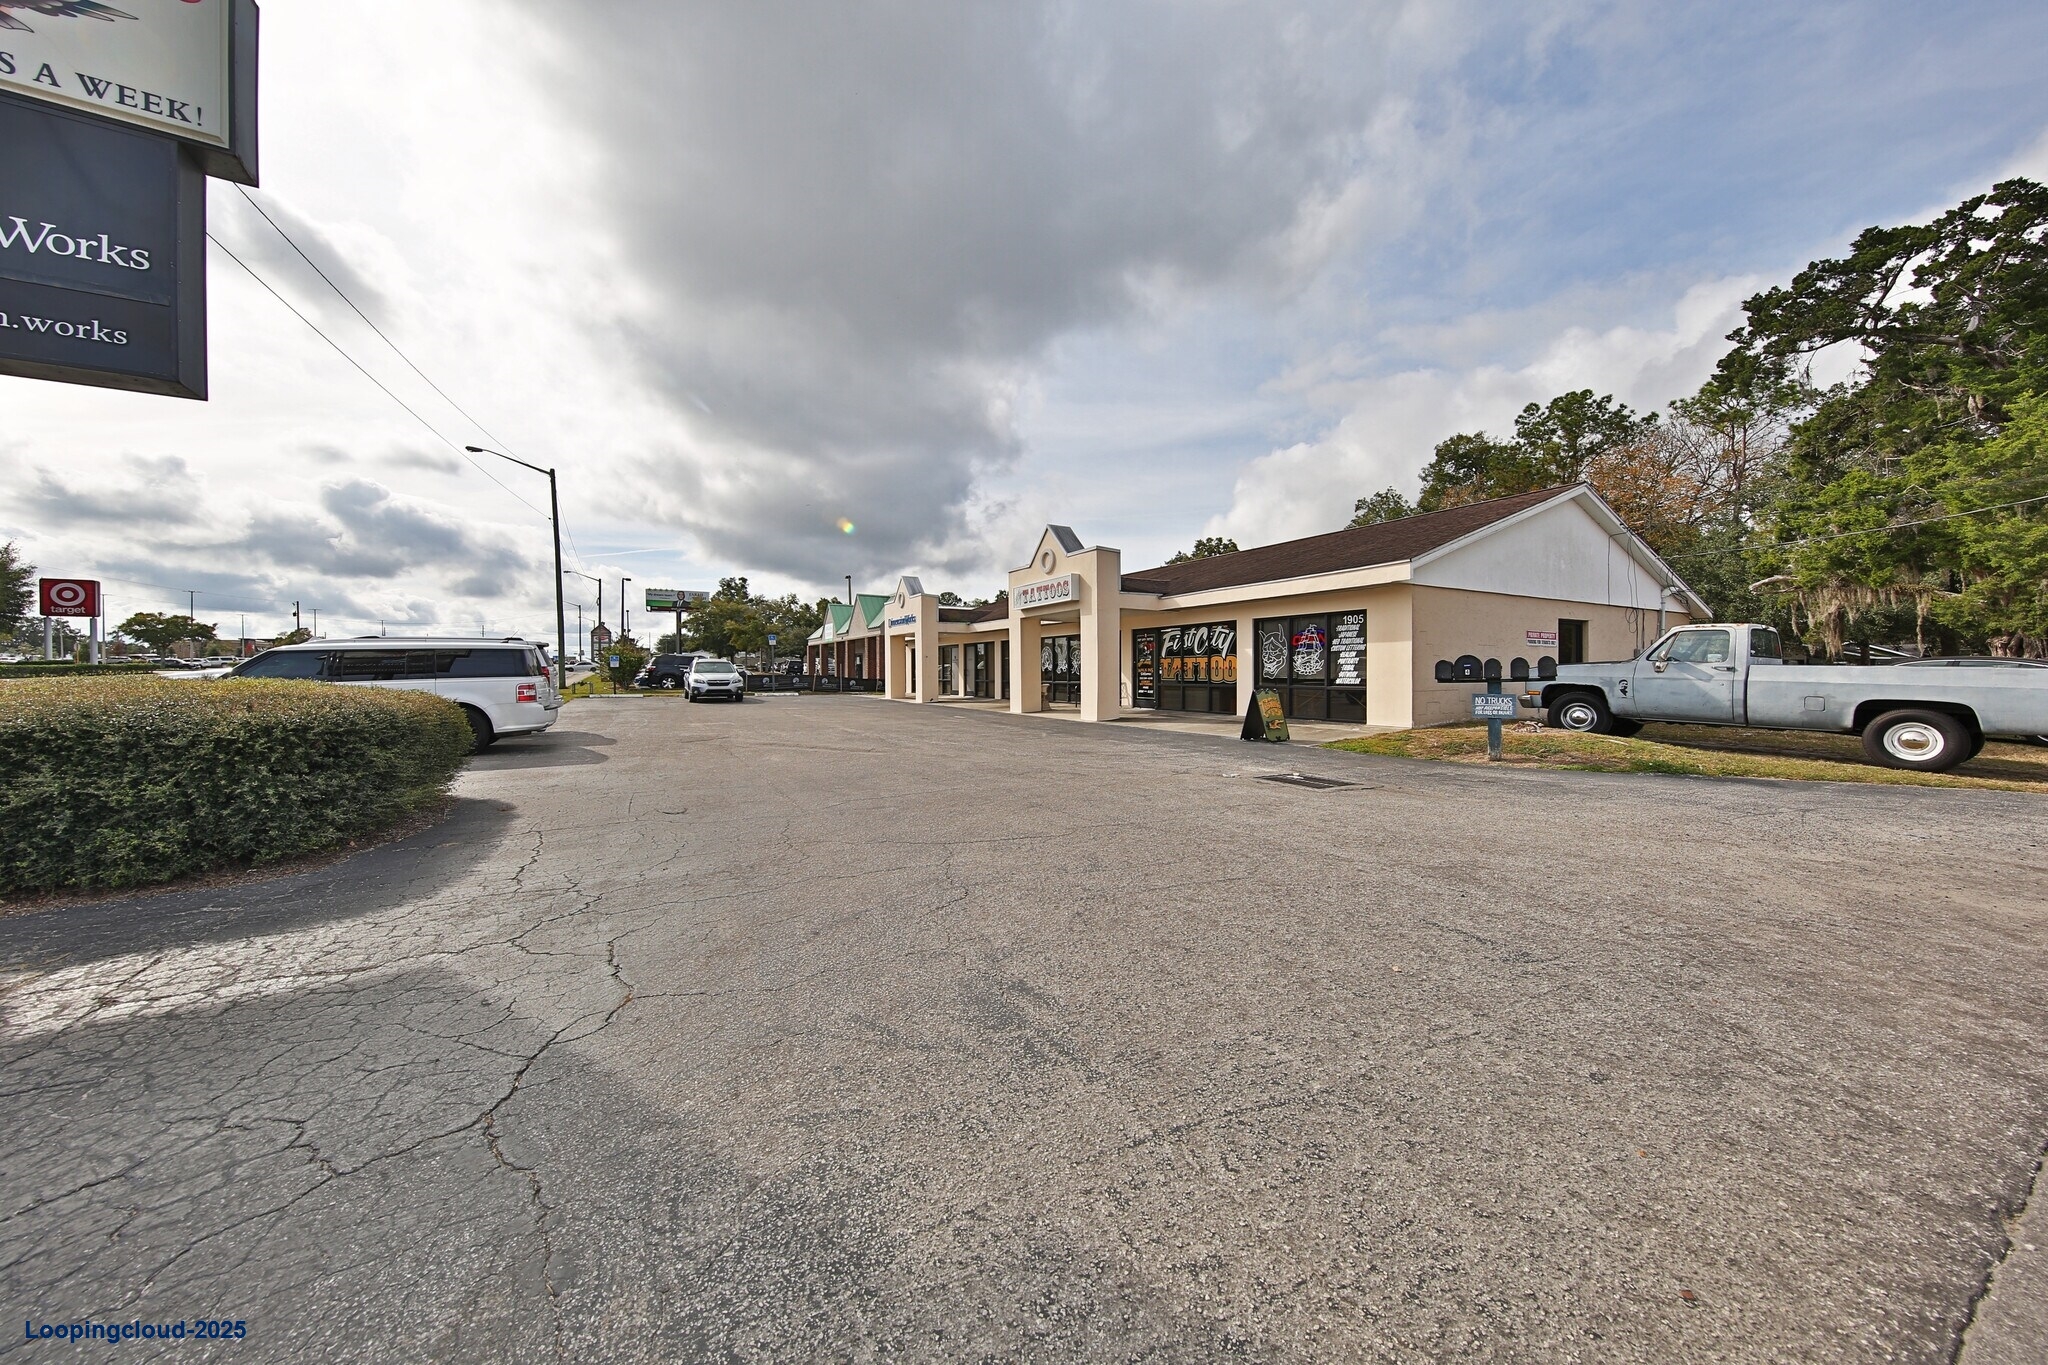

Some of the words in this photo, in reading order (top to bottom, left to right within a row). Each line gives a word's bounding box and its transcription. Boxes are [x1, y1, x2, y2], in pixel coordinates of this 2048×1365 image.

[32, 62, 62, 88] A
[75, 72, 202, 126] WEEK!
[1022, 580, 1070, 604] TATTOOS
[50, 605, 86, 615] target
[1342, 614, 1364, 624] 1905
[1161, 627, 1197, 658] Fist
[1194, 626, 1235, 660] Cty
[1160, 655, 1237, 684] TATTOO
[1487, 697, 1513, 705] TRUCKS
